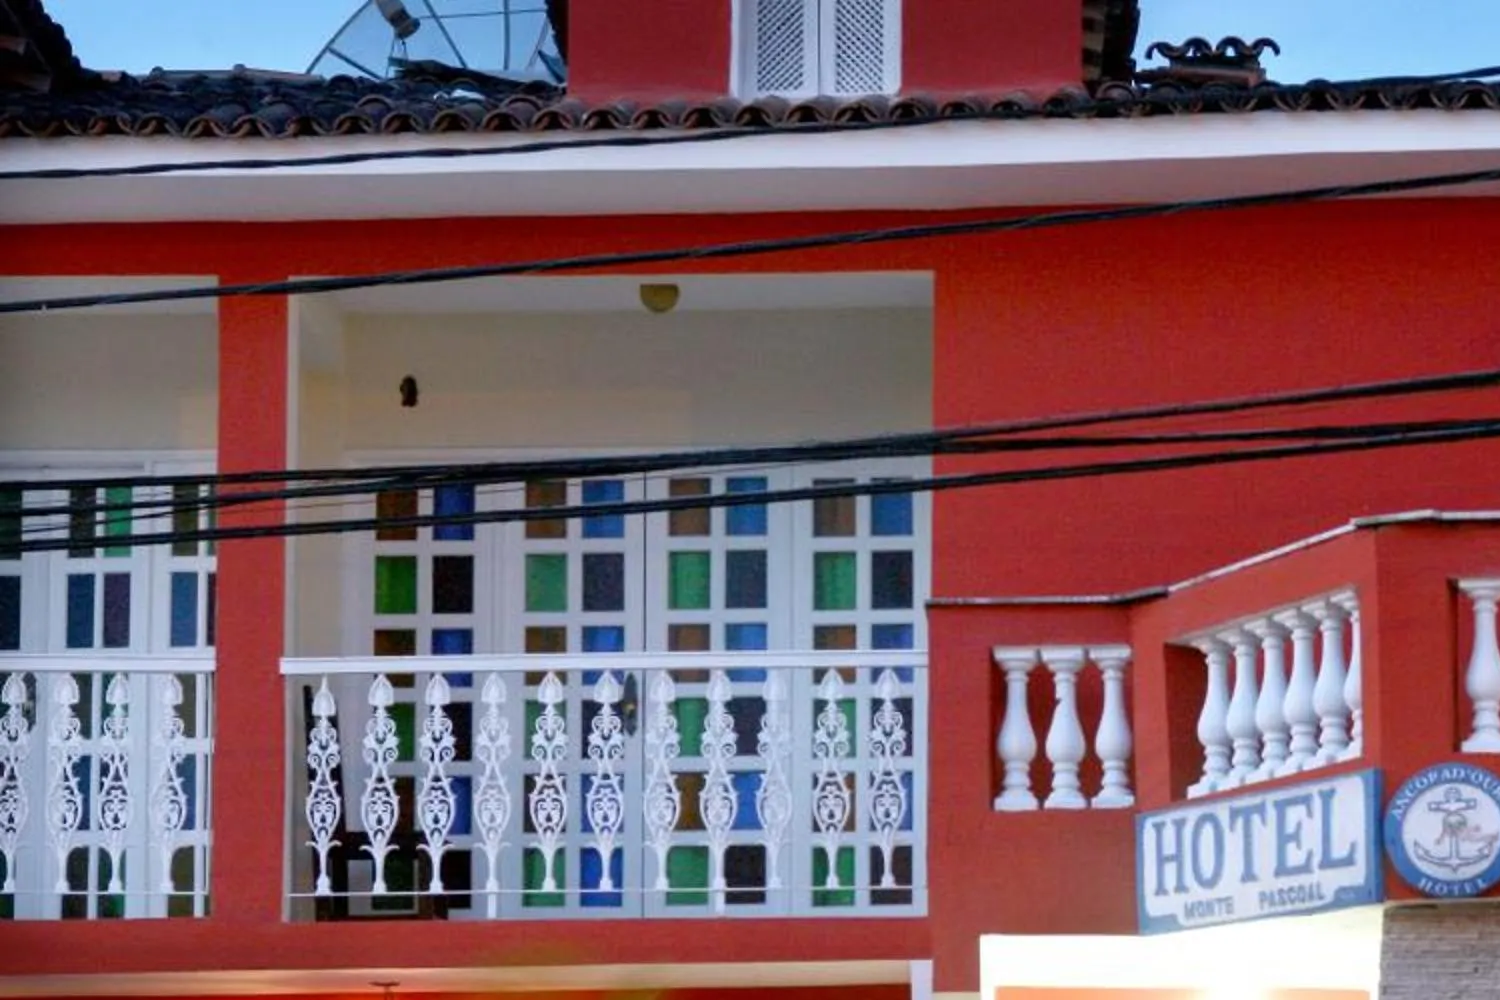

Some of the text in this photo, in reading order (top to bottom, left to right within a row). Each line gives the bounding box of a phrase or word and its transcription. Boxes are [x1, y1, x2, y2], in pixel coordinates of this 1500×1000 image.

[1151, 788, 1357, 897] HOTEL
[1184, 881, 1328, 921] MONTE PASCOAL
[1418, 876, 1486, 896] HOTEL
